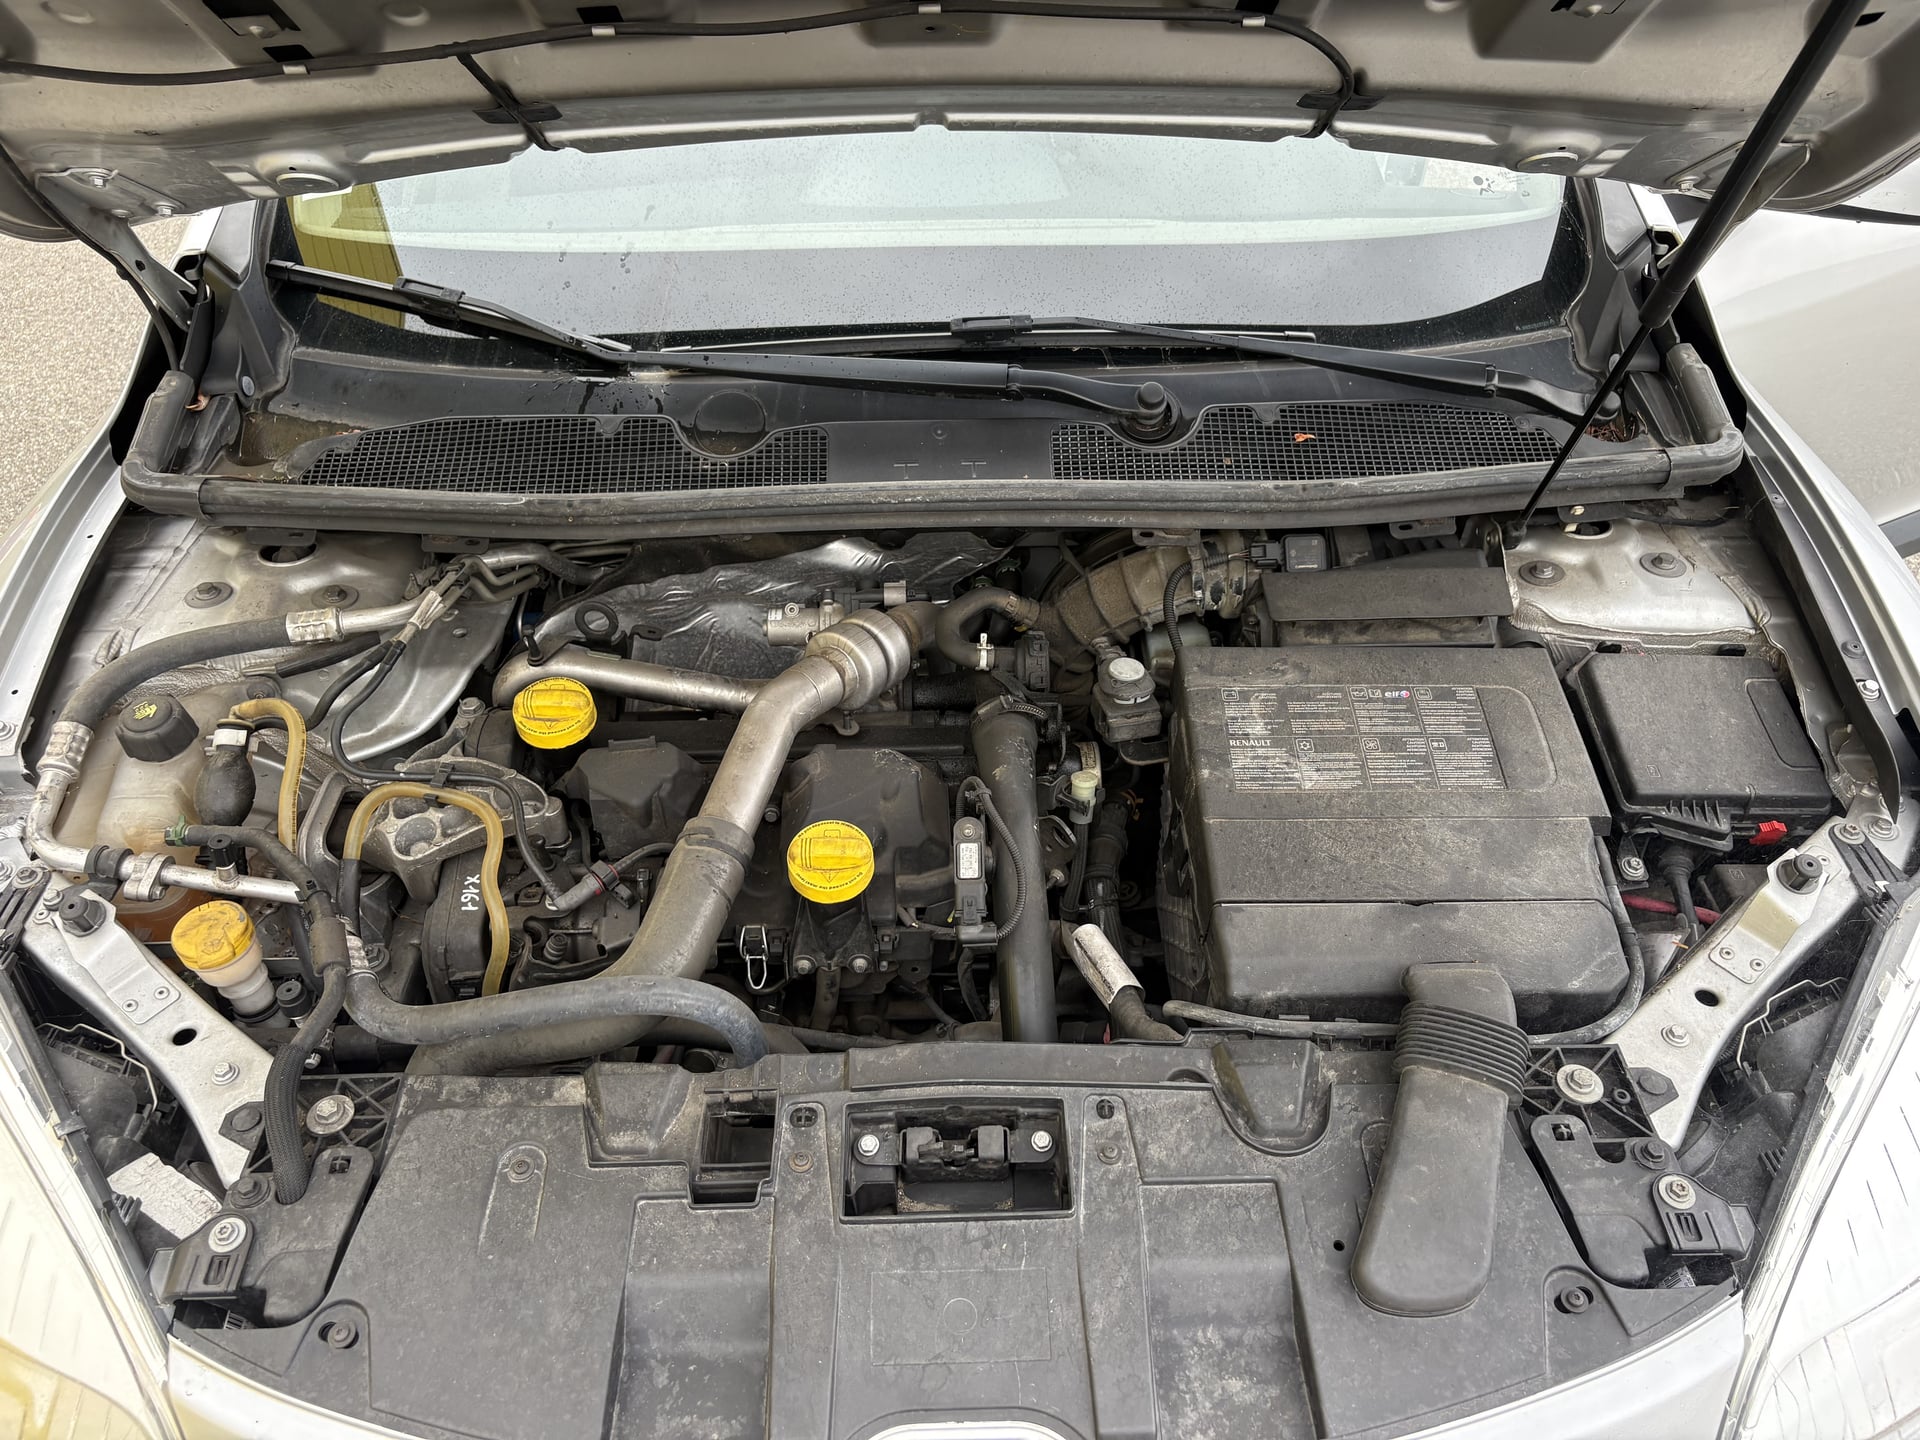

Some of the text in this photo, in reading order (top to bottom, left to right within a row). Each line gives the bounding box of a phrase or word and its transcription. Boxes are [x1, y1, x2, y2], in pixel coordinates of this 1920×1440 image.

[1384, 690, 1401, 698] elf
[1229, 739, 1272, 747] RENAULT
[461, 874, 480, 910] X161
